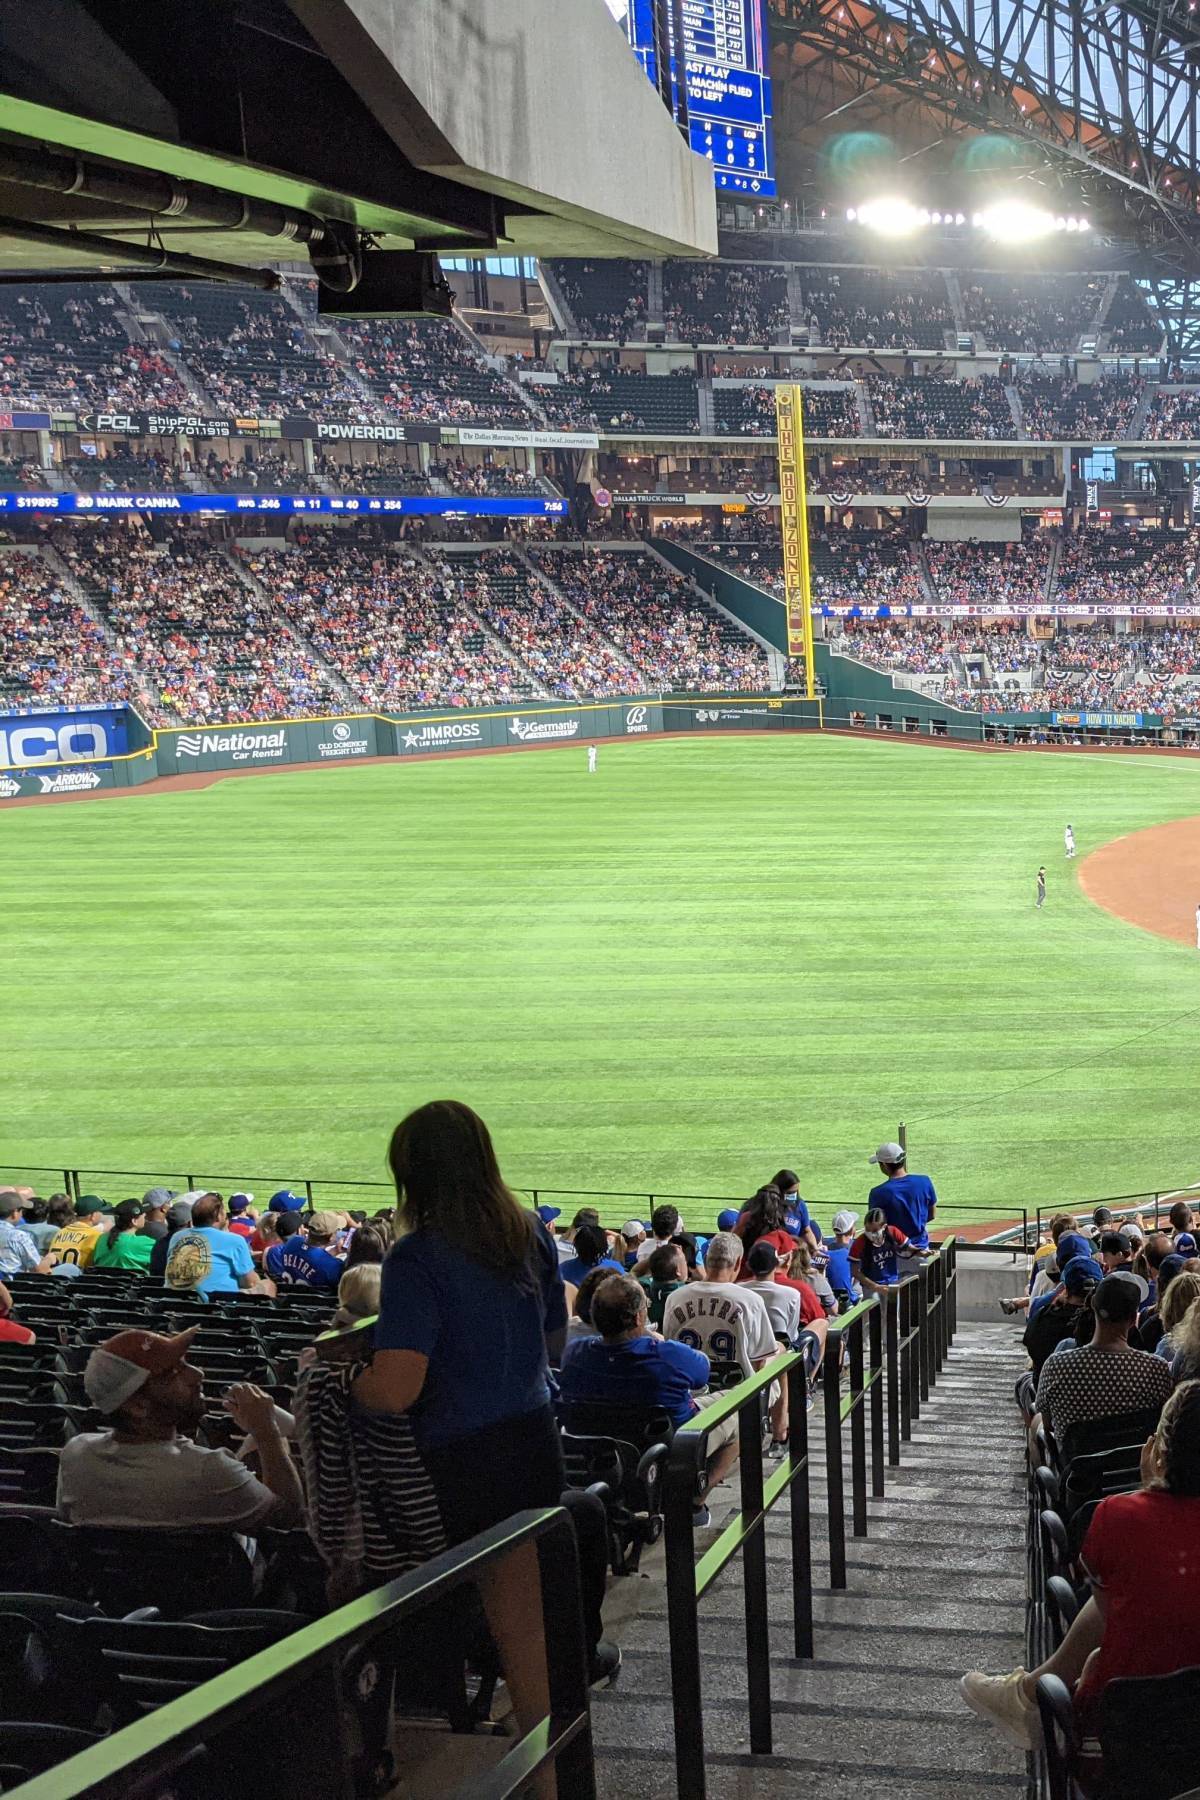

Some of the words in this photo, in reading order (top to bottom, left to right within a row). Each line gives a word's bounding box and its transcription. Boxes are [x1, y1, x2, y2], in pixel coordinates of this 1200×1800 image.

[705, 65, 730, 79] PLAY
[689, 87, 702, 98] TO
[702, 90, 723, 102] LEFT
[728, 84, 753, 98] FLIED
[705, 135, 712, 145] 4
[726, 139, 733, 149] 0
[747, 143, 754, 153] 2
[727, 153, 734, 163] 0
[748, 157, 755, 167] 3
[97, 415, 140, 430] PGL
[148, 416, 229, 427] ShipPGL.com
[149, 426, 230, 436] 877.701.1919
[317, 424, 405, 440] POWERADE
[515, 434, 528, 442] News
[782, 416, 792, 459] THE
[637, 495, 661, 503] TRUCK
[784, 473, 795, 515] HOT
[17, 496, 59, 508] $19895
[96, 496, 134, 508] MARK
[136, 497, 181, 508] CANHA
[258, 499, 281, 509] .246
[309, 500, 321, 509] 11
[346, 500, 359, 509] 40
[384, 500, 402, 510] 354
[544, 502, 563, 511] 7:56
[787, 529, 798, 586] ZONE
[531, 719, 578, 733] Germania
[1086, 713, 1102, 725] HOW
[1104, 713, 1112, 725] TO
[627, 723, 648, 733] SPORTS
[318, 743, 332, 751] OLD
[232, 751, 249, 761] Car
[252, 748, 283, 760] Rental
[55, 771, 91, 785] ARROW
[55, 1231, 88, 1244] MUNCY
[283, 1253, 316, 1280] BELTRE
[673, 1297, 741, 1325] BELTRE
